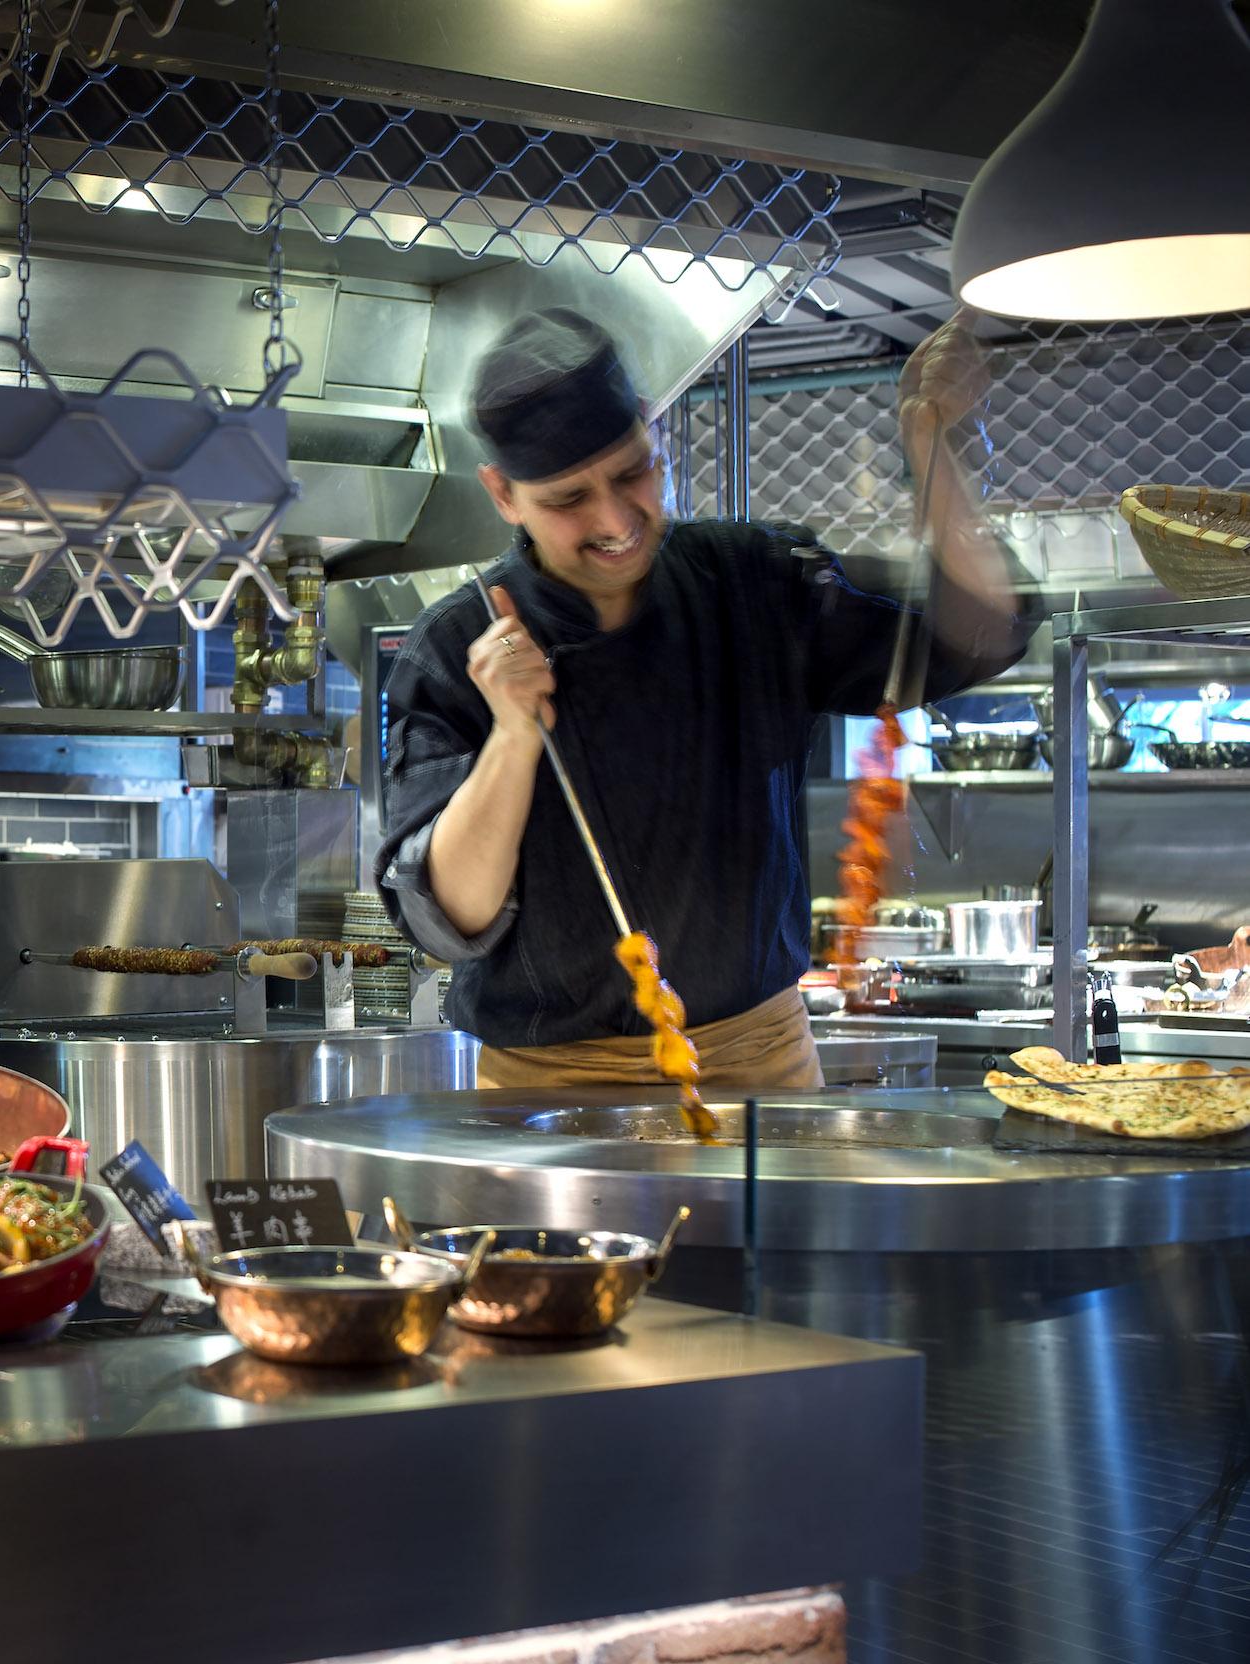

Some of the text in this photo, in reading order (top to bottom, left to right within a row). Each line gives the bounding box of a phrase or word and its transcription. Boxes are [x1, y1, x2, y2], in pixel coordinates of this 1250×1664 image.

[213, 1183, 318, 1206] Lamb Kebab
[229, 1208, 314, 1247] 羊肉串
